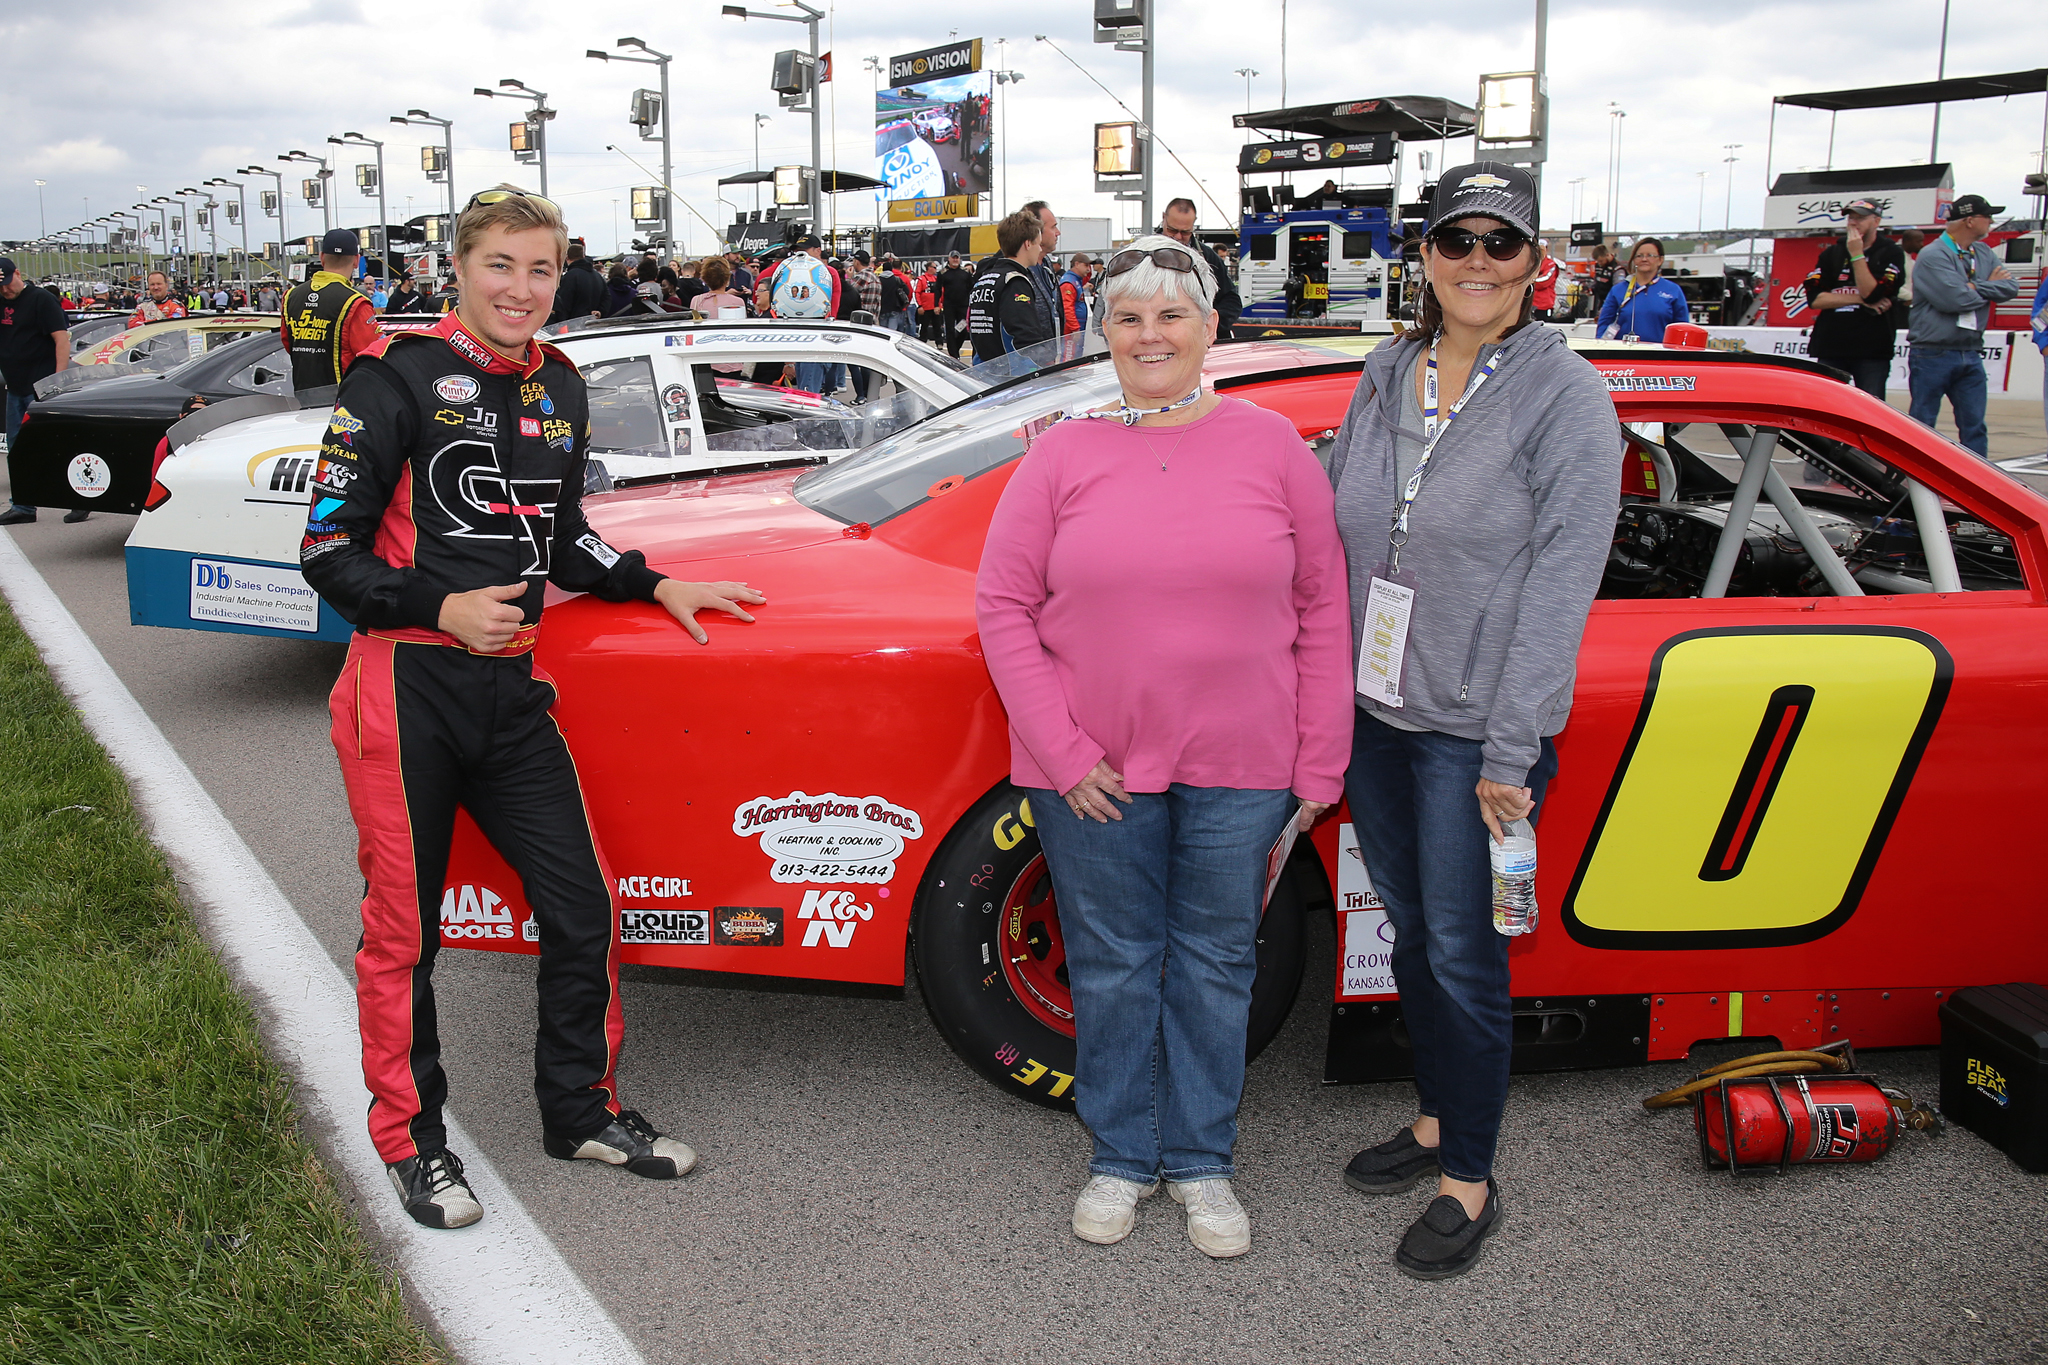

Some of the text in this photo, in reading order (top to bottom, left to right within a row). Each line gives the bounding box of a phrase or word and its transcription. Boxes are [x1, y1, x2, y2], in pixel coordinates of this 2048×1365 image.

[891, 48, 970, 79] ISM VISION
[1235, 116, 1246, 127] 3
[1273, 149, 1298, 157] TRACKER
[1301, 142, 1322, 162] 3
[1346, 142, 1374, 151] TRACKER
[1452, 187, 1514, 198] RACING
[744, 237, 768, 251] Degree
[1737, 279, 1745, 288] 3
[455, 333, 491, 361] G-FORCE
[1774, 342, 1796, 355] FLAT
[472, 354, 486, 366] GEAR
[440, 385, 470, 399] xfinity
[520, 382, 546, 396] FLEX
[522, 392, 547, 406] SEAL
[542, 418, 572, 432] FLEX
[544, 428, 572, 443] TAPE
[76, 456, 100, 465] GUS'S
[196, 563, 232, 591] Db
[234, 580, 315, 598] Sales Company
[1374, 584, 1388, 592] DISPLAY
[1400, 592, 1410, 600] TIMES
[196, 592, 313, 612] Industrial Machine Products
[197, 606, 310, 627] finddieselengines.com
[1370, 610, 1396, 677] 2017
[1561, 624, 1955, 951] 0
[740, 799, 916, 832] Harrington Bros.
[778, 836, 884, 846] HEATING & COOLING
[819, 846, 840, 856] INC.
[777, 864, 888, 877] 913-422-5444
[614, 876, 693, 899] ACE GIRL
[440, 884, 513, 924] MAC
[731, 932, 760, 942] Racing
[1348, 976, 1386, 990] KANSAS
[1967, 1058, 2006, 1090] FLEX
[1966, 1072, 2006, 1098] SEAL
[1976, 1085, 2004, 1106] Racing
